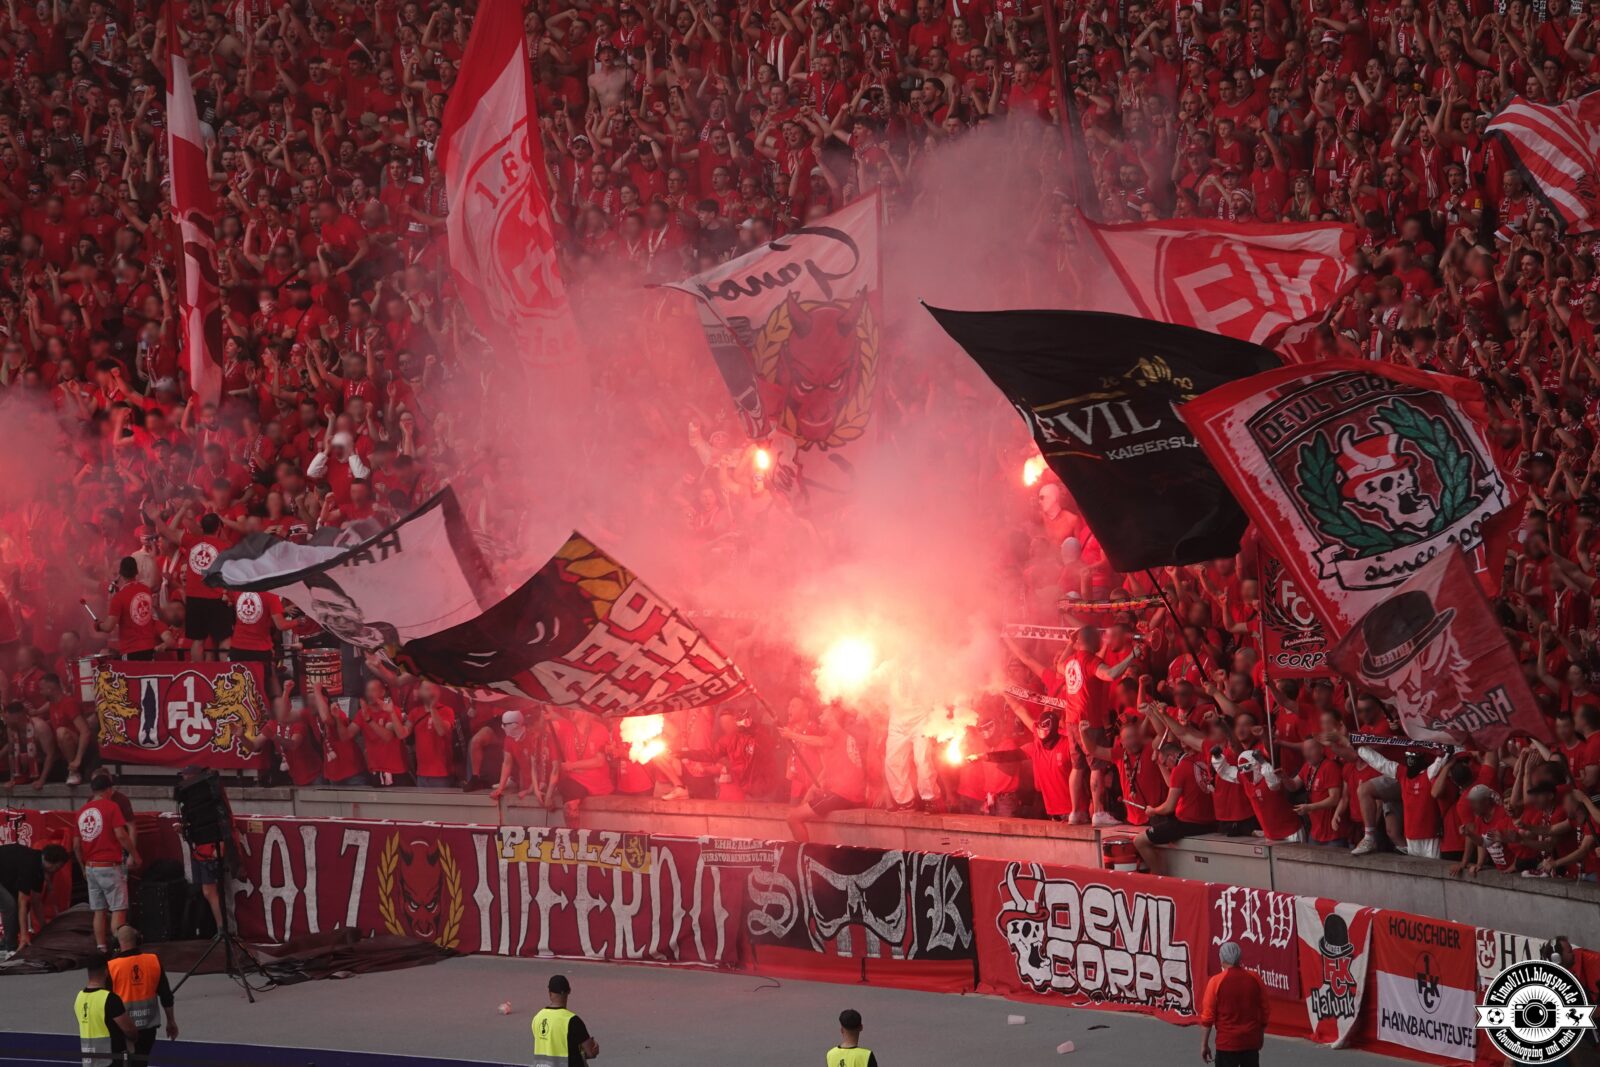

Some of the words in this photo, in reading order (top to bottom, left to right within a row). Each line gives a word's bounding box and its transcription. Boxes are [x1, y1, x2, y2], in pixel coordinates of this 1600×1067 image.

[1256, 394, 1334, 447] DEVIL
[1365, 545, 1438, 581] since
[501, 826, 622, 866] PFALZ
[1389, 916, 1461, 950] HOUSCHDER
[1048, 940, 1193, 1008] CORPS
